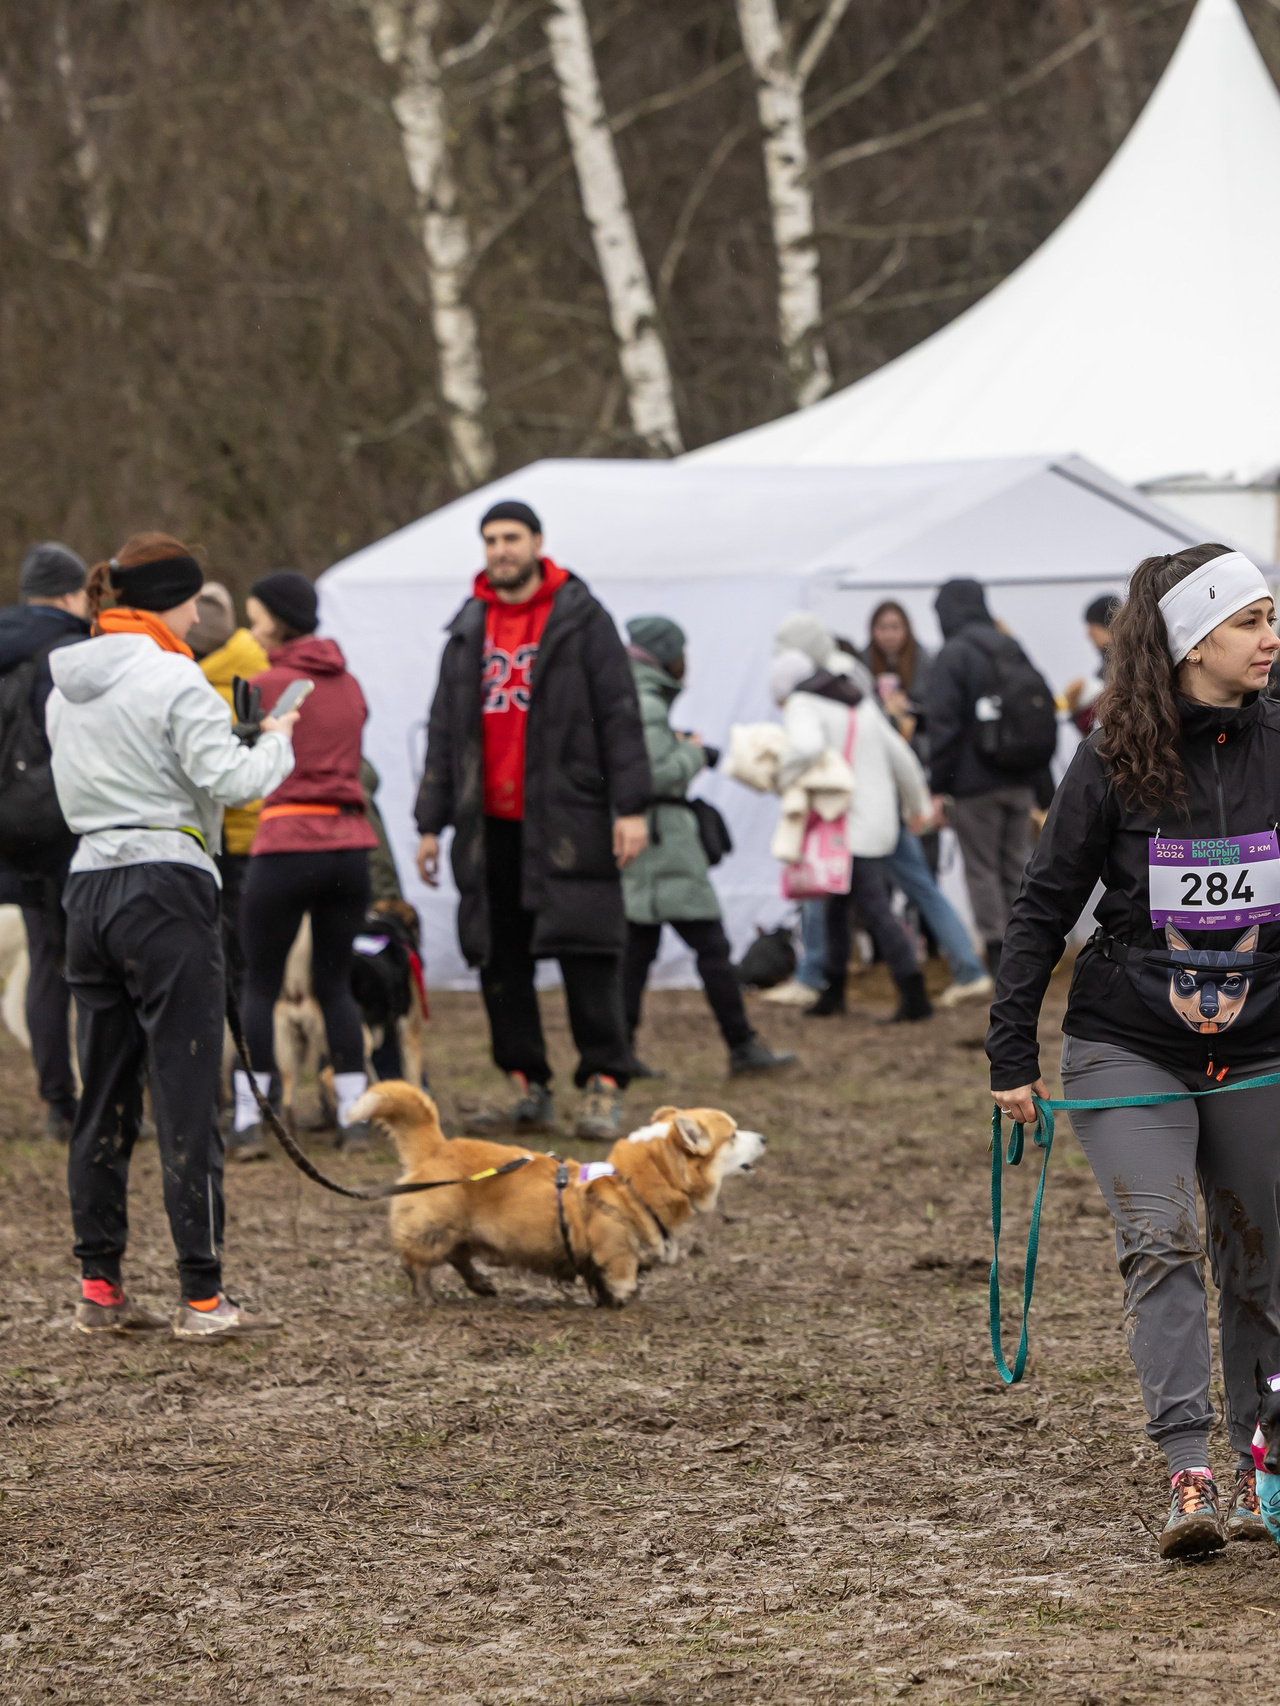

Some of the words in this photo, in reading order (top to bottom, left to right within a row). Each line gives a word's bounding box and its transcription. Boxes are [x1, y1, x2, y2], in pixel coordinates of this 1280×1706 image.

[1156, 843, 1184, 851] 11/04
[1191, 839, 1229, 850] КРОСС
[1248, 845, 1256, 853] 2
[1156, 851, 1185, 859] 2026
[1192, 845, 1240, 858] БЫСТРЫЙ
[1180, 869, 1254, 906] 284
